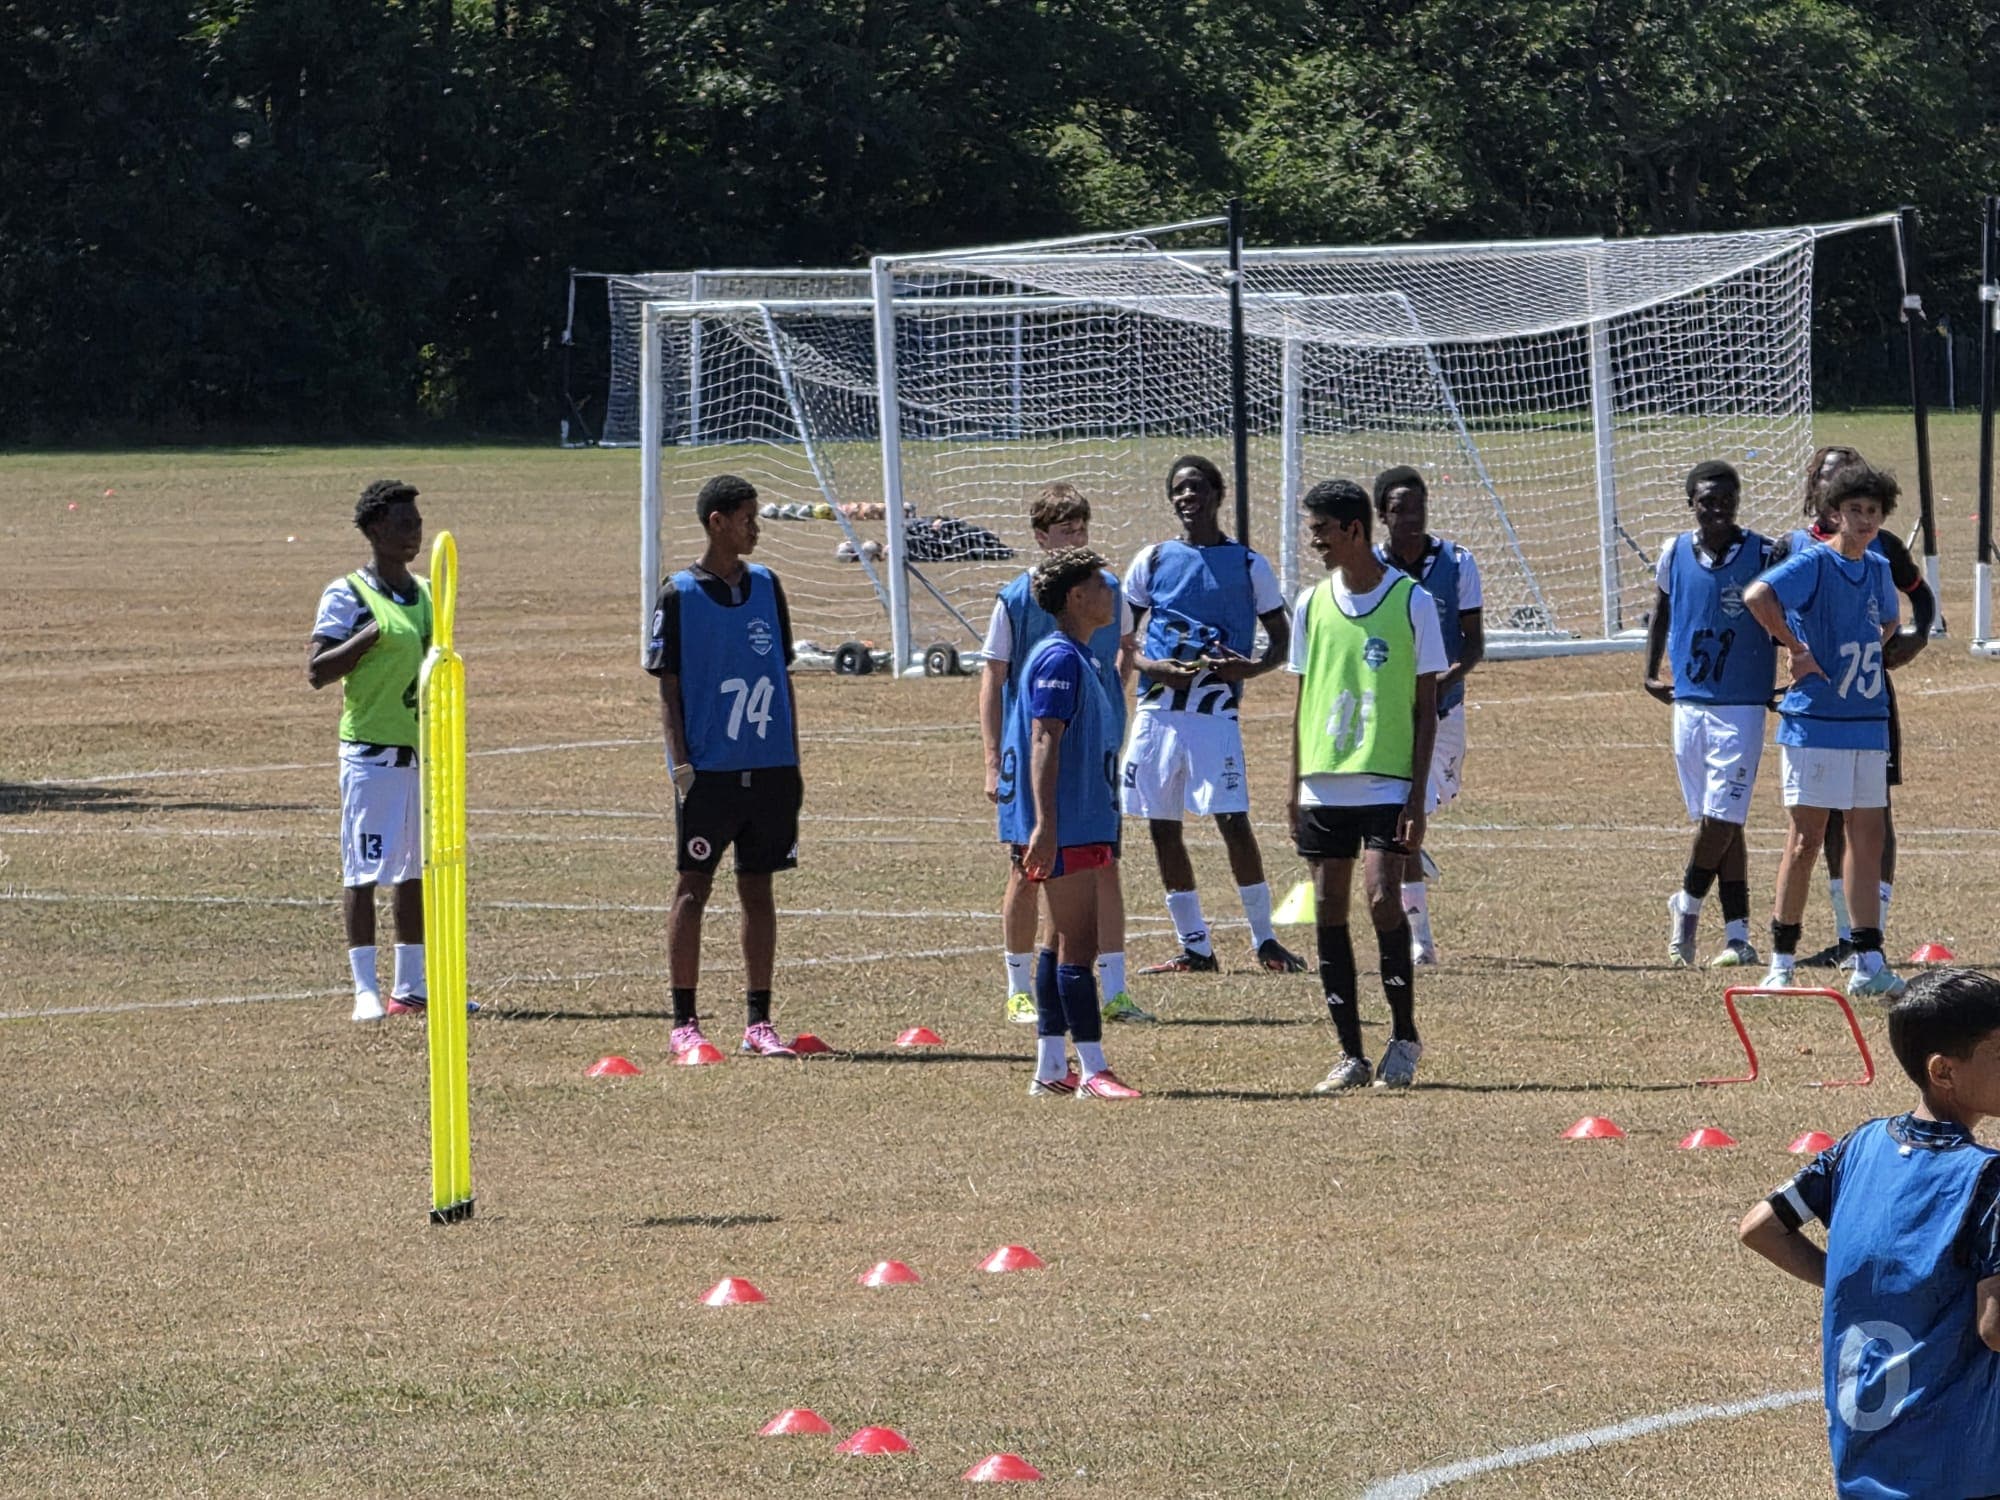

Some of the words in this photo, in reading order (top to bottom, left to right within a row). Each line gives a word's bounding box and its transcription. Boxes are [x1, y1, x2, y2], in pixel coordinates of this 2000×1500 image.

[1686, 628, 1736, 684] 51
[1838, 641, 1884, 699] 75
[720, 675, 774, 741] 74
[360, 833, 383, 861] 13
